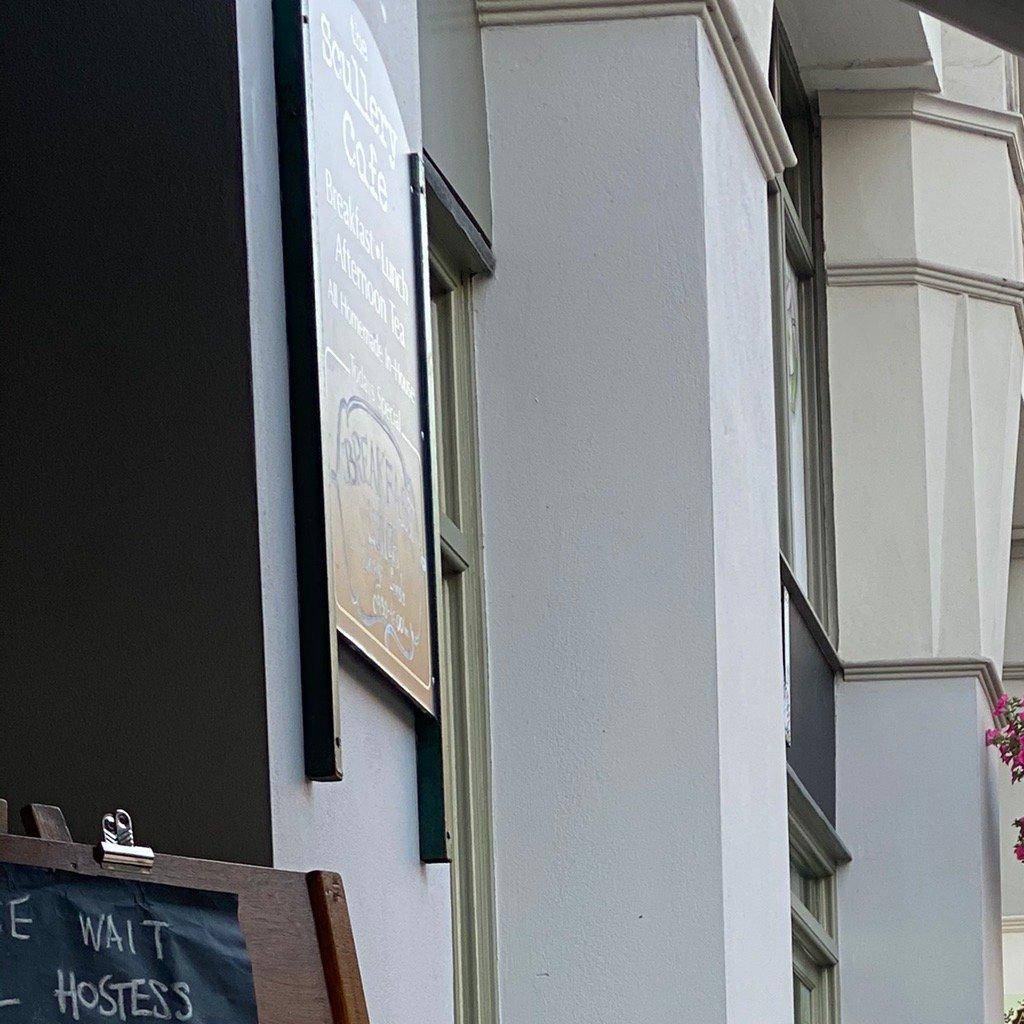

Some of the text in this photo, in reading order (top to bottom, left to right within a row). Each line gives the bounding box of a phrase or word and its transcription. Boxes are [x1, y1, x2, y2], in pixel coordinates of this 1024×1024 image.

[320, 12, 398, 170] Scullery
[342, 110, 388, 213] Cafe
[324, 168, 409, 305] Breakfast Lunch
[328, 278, 339, 310] All
[340, 291, 384, 362] Homemade
[335, 232, 406, 349] Afternoon Tea
[79, 915, 169, 959] WAIT
[55, 969, 195, 1021] HOSTESS
